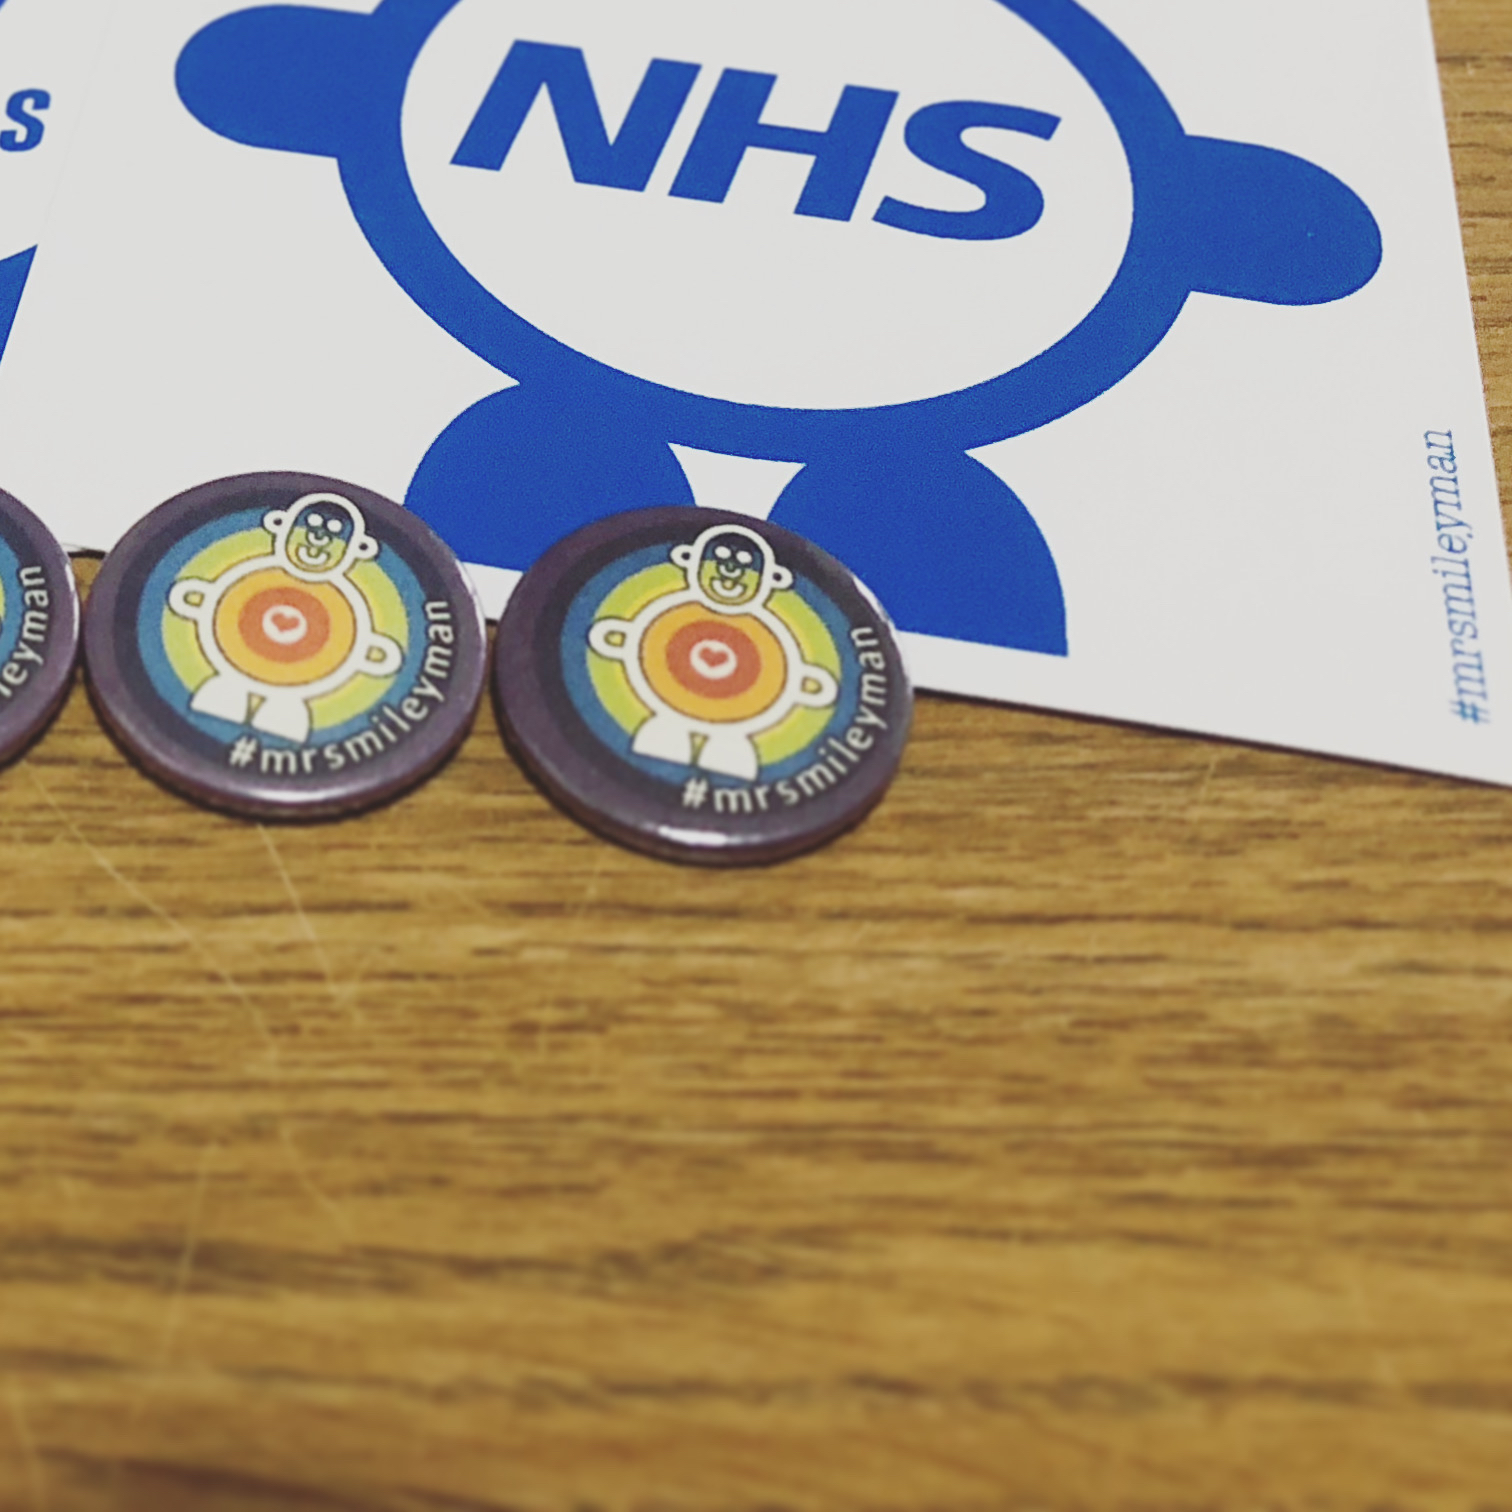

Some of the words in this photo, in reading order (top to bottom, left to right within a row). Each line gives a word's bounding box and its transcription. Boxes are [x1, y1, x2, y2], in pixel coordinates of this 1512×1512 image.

[450, 39, 1062, 241] NHS
[1423, 429, 1491, 726] #mrsmileyman
[228, 600, 455, 776] #mrsmileyman
[682, 626, 889, 815] #mrsmileyman
